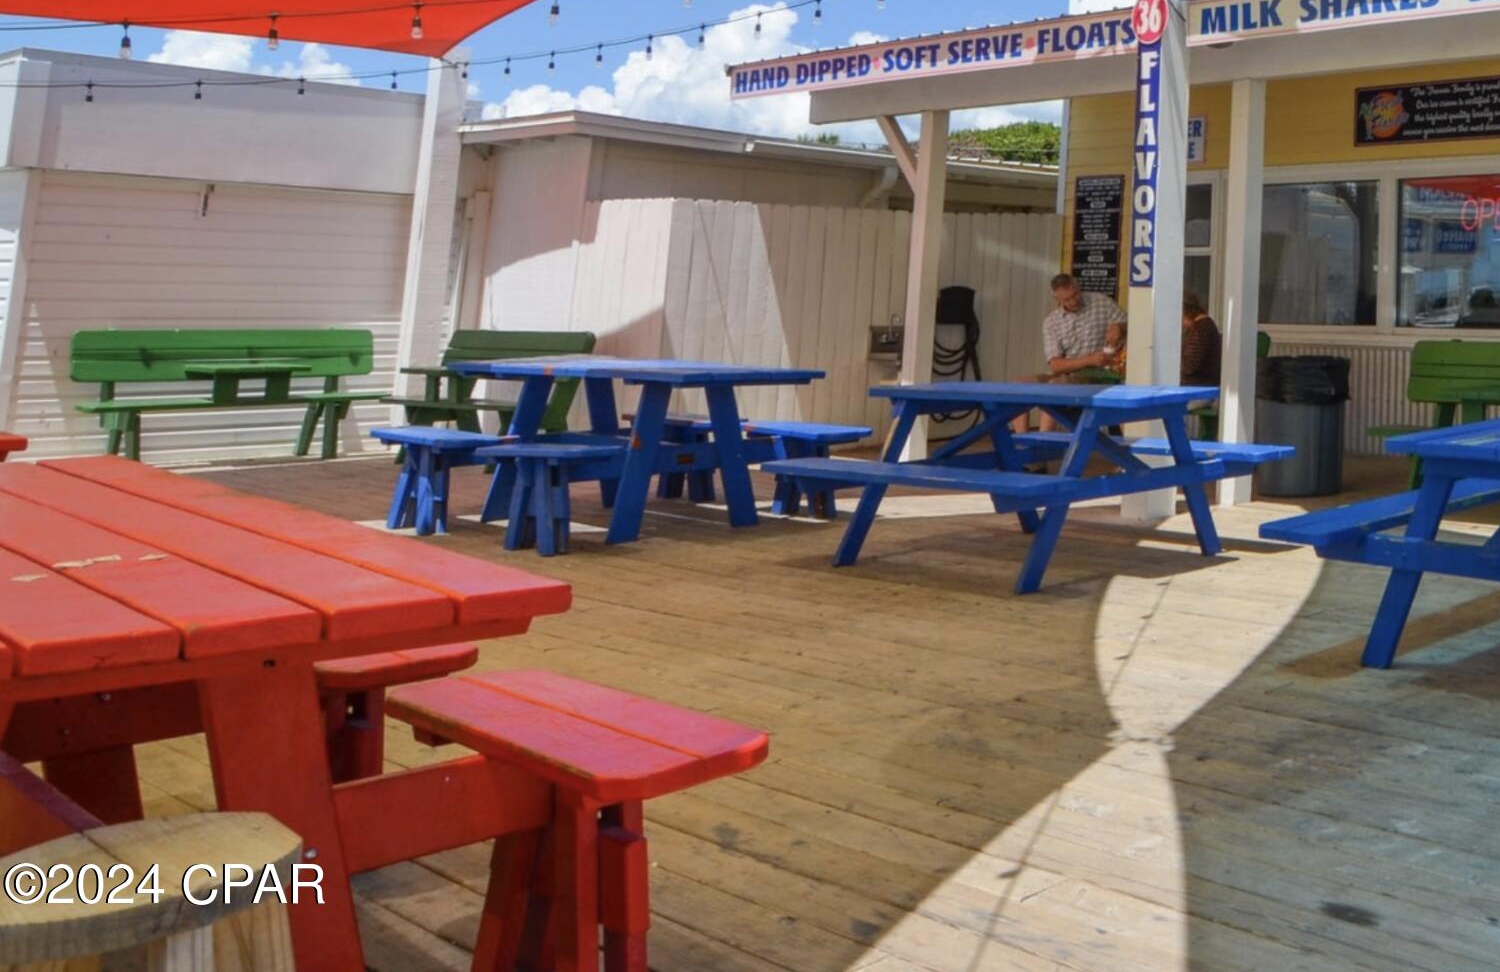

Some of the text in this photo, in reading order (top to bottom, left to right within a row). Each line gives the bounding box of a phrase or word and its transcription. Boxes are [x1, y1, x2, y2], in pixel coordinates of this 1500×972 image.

[735, 17, 1136, 94] HAND DIPPED SOFT SERVE FLOATS
[1136, 0, 1162, 34] 36
[1131, 51, 1158, 282] FLAVORS
